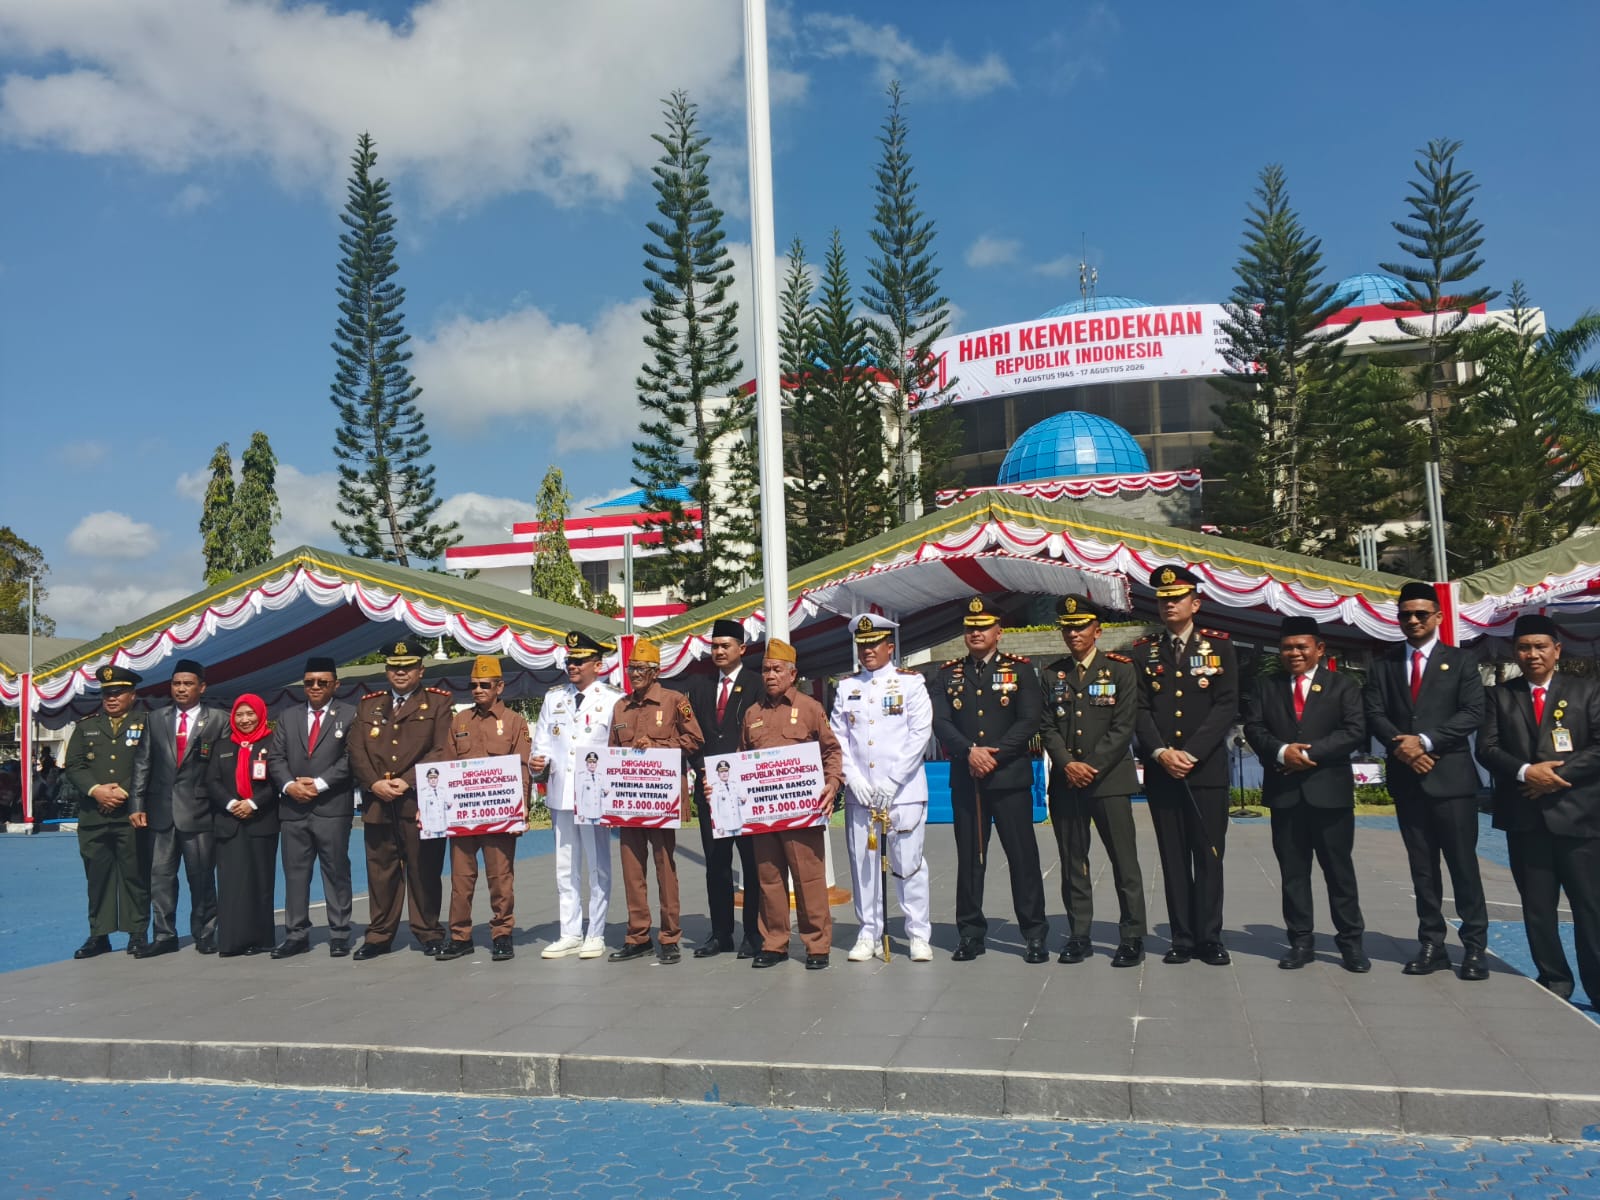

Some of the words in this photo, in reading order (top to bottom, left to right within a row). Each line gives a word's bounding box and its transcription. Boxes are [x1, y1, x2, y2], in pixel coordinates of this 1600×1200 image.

[959, 331, 1011, 363] HARI
[1019, 310, 1203, 352] KEMERDEKAAN
[995, 350, 1070, 376] REPUBLIK
[1075, 341, 1163, 364] INDONESIA
[1022, 373, 1055, 384] AGUSTUS
[1057, 370, 1075, 379] 1945
[1090, 365, 1124, 375] AGUSTUS
[1125, 363, 1145, 372] 2026
[622, 760, 662, 768] DIRGAHAYU
[756, 758, 800, 771] DIRGAHAYU
[463, 768, 502, 778] DIRGAHAYU
[639, 768, 677, 777] INDONESIA
[740, 770, 775, 782] REPUBLIK
[776, 764, 819, 776] INDONESIA
[448, 780, 480, 788] REPUBLIK
[481, 776, 518, 784] INDONESIA
[748, 784, 784, 794] PENERIMA
[786, 779, 816, 788] BANSOS
[454, 791, 486, 799] PENERIMA
[488, 788, 515, 797] BANSOS
[754, 794, 778, 803] UNTUK
[780, 790, 812, 799] VETERAN
[459, 800, 480, 808] UNTUK
[482, 798, 510, 806] VETERAN
[612, 800, 625, 808] RP.
[627, 800, 671, 810] 5.000.000
[752, 805, 766, 816] RP.
[769, 799, 817, 813] 5.000.000
[457, 810, 469, 819] RP.
[472, 806, 515, 818] 5.000.000
